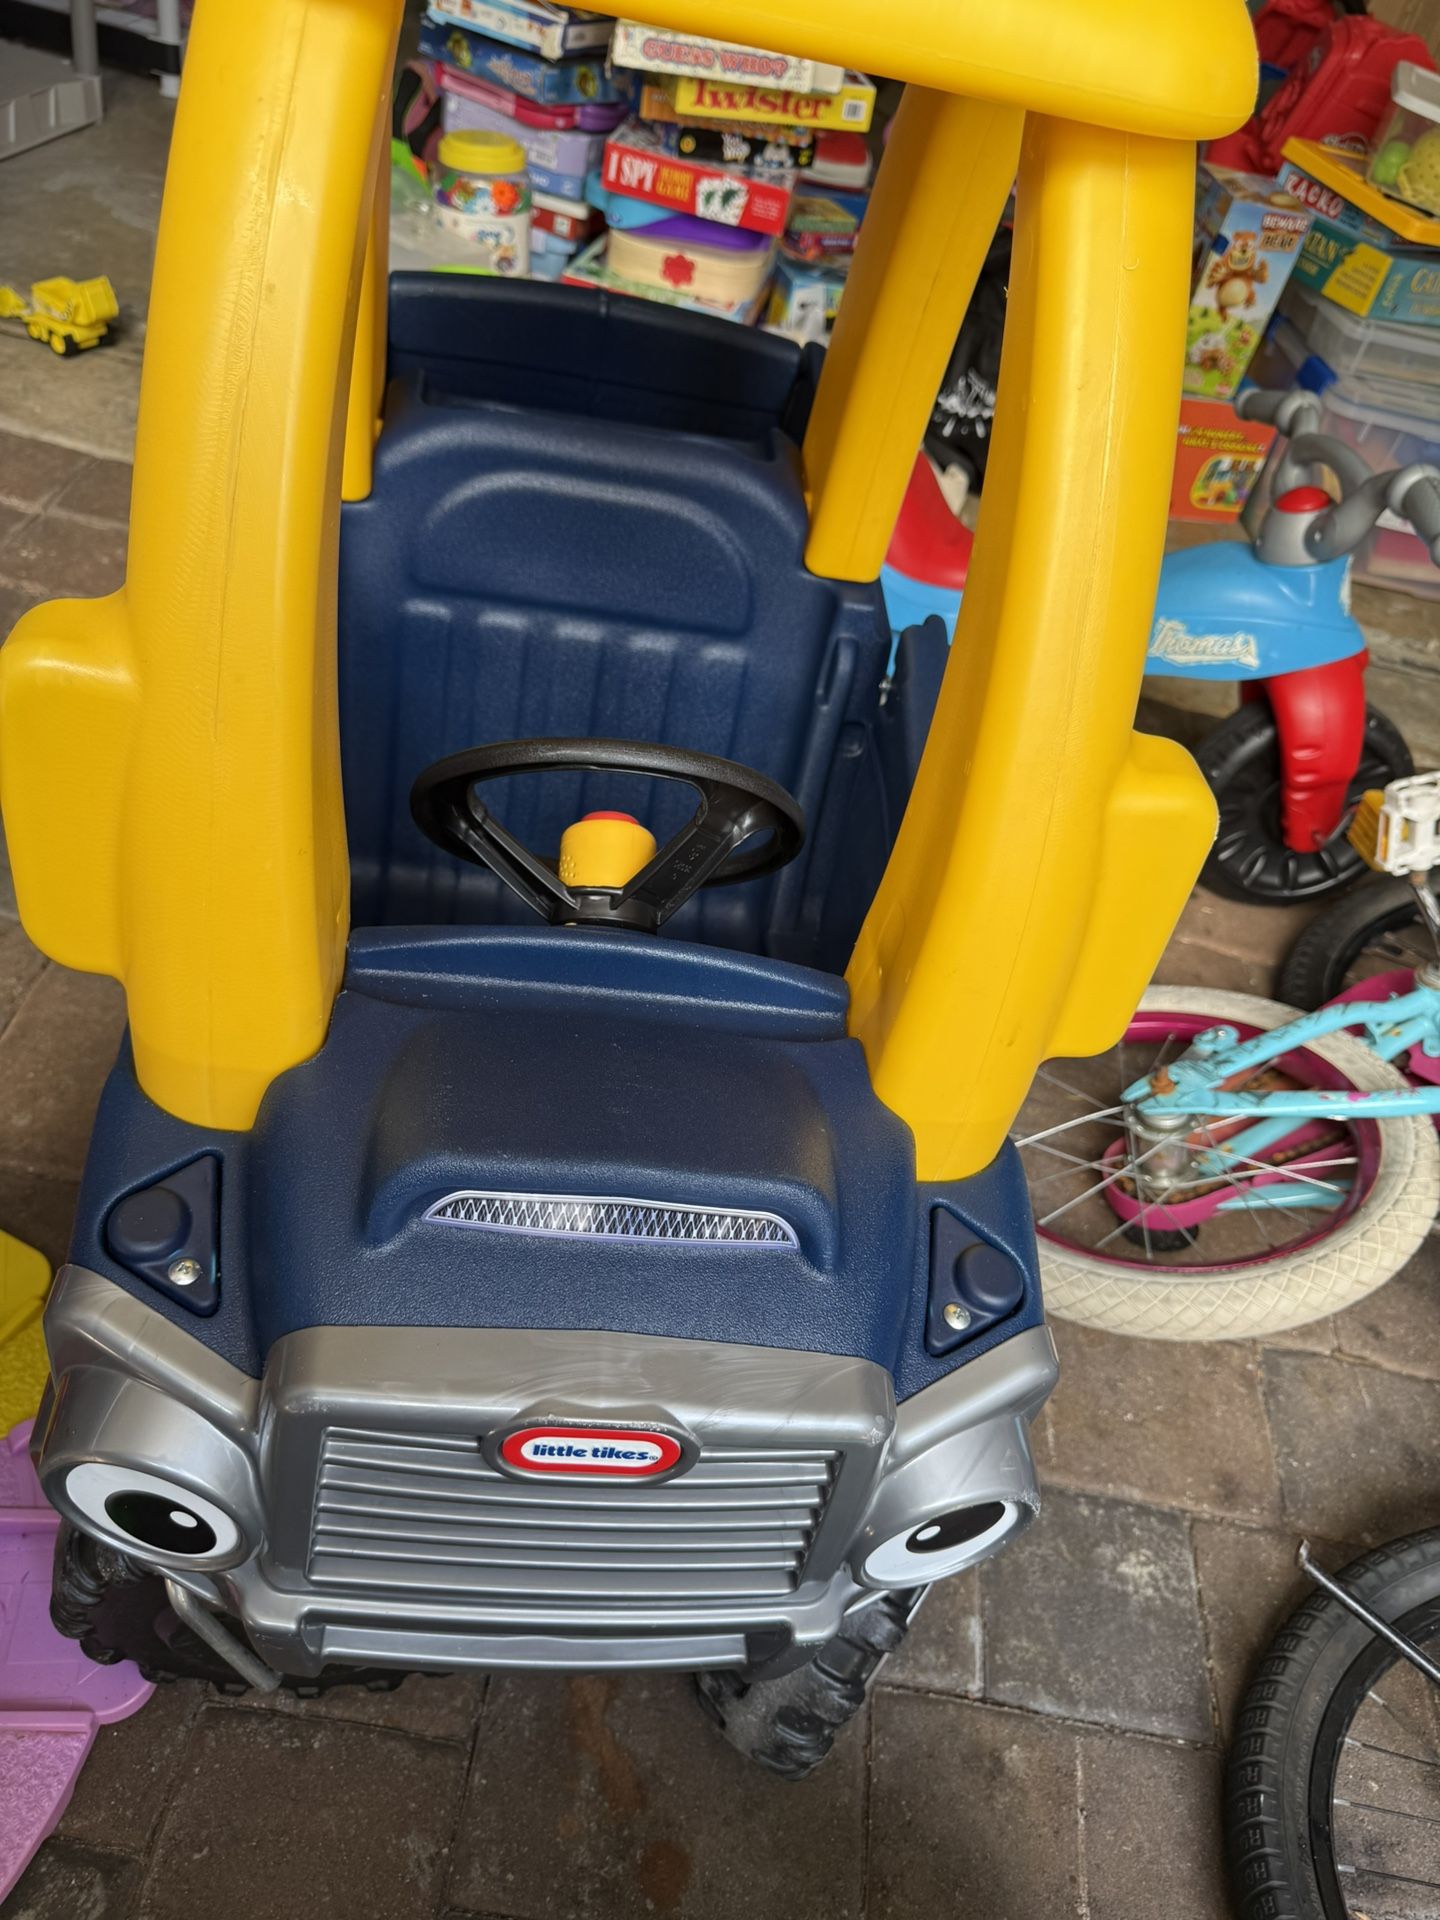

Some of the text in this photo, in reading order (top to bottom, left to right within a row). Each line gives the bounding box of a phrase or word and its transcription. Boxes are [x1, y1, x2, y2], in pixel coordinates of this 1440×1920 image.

[643, 38, 789, 79] GUESS WHO?
[690, 78, 832, 120] Twister
[607, 150, 658, 193] I SPY
[532, 1444, 650, 1460] little tikes
